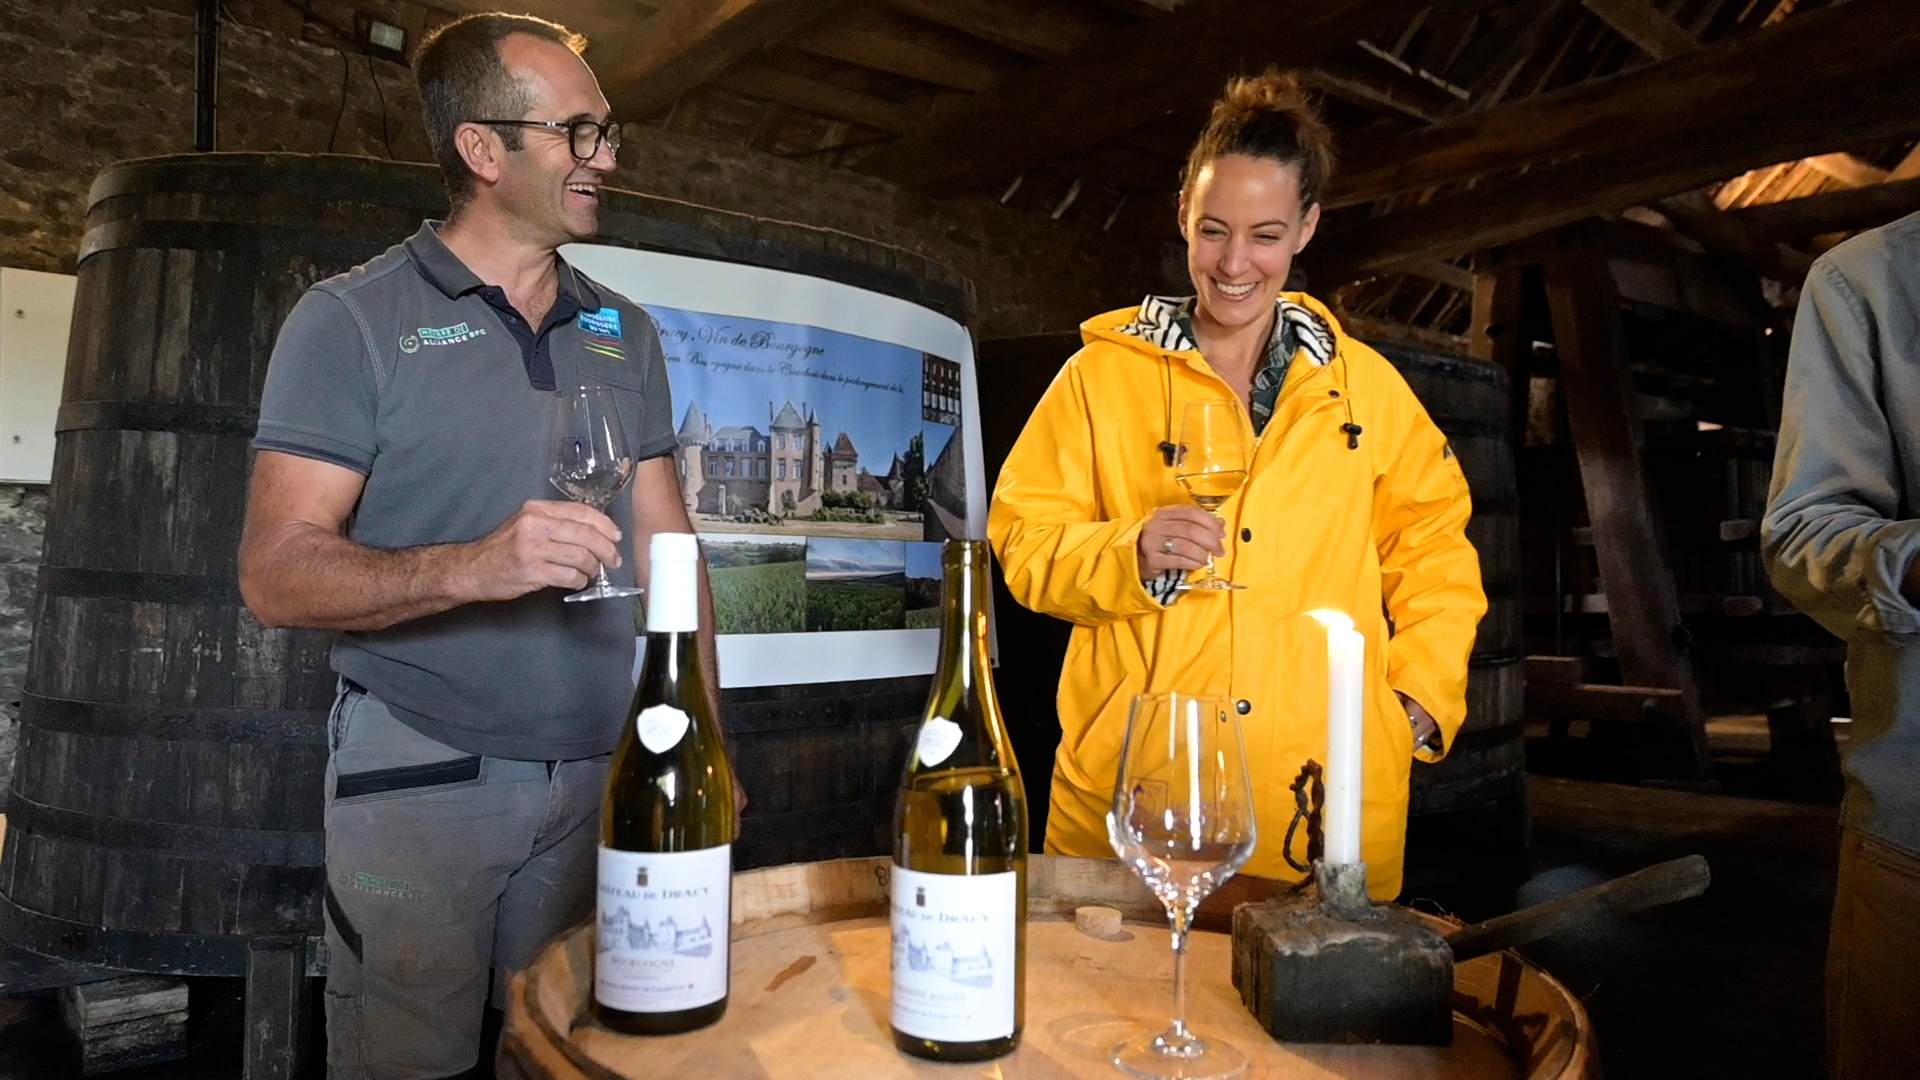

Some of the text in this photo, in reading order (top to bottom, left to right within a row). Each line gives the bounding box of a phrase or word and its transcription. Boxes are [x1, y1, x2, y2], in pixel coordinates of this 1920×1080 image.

[423, 334, 468, 346] ALLIANCE
[698, 325, 731, 343] Vin
[731, 332, 747, 347] de
[749, 331, 825, 360] Bourgogne
[353, 883, 404, 899] ALLIANCE
[661, 886, 710, 900] DRACY
